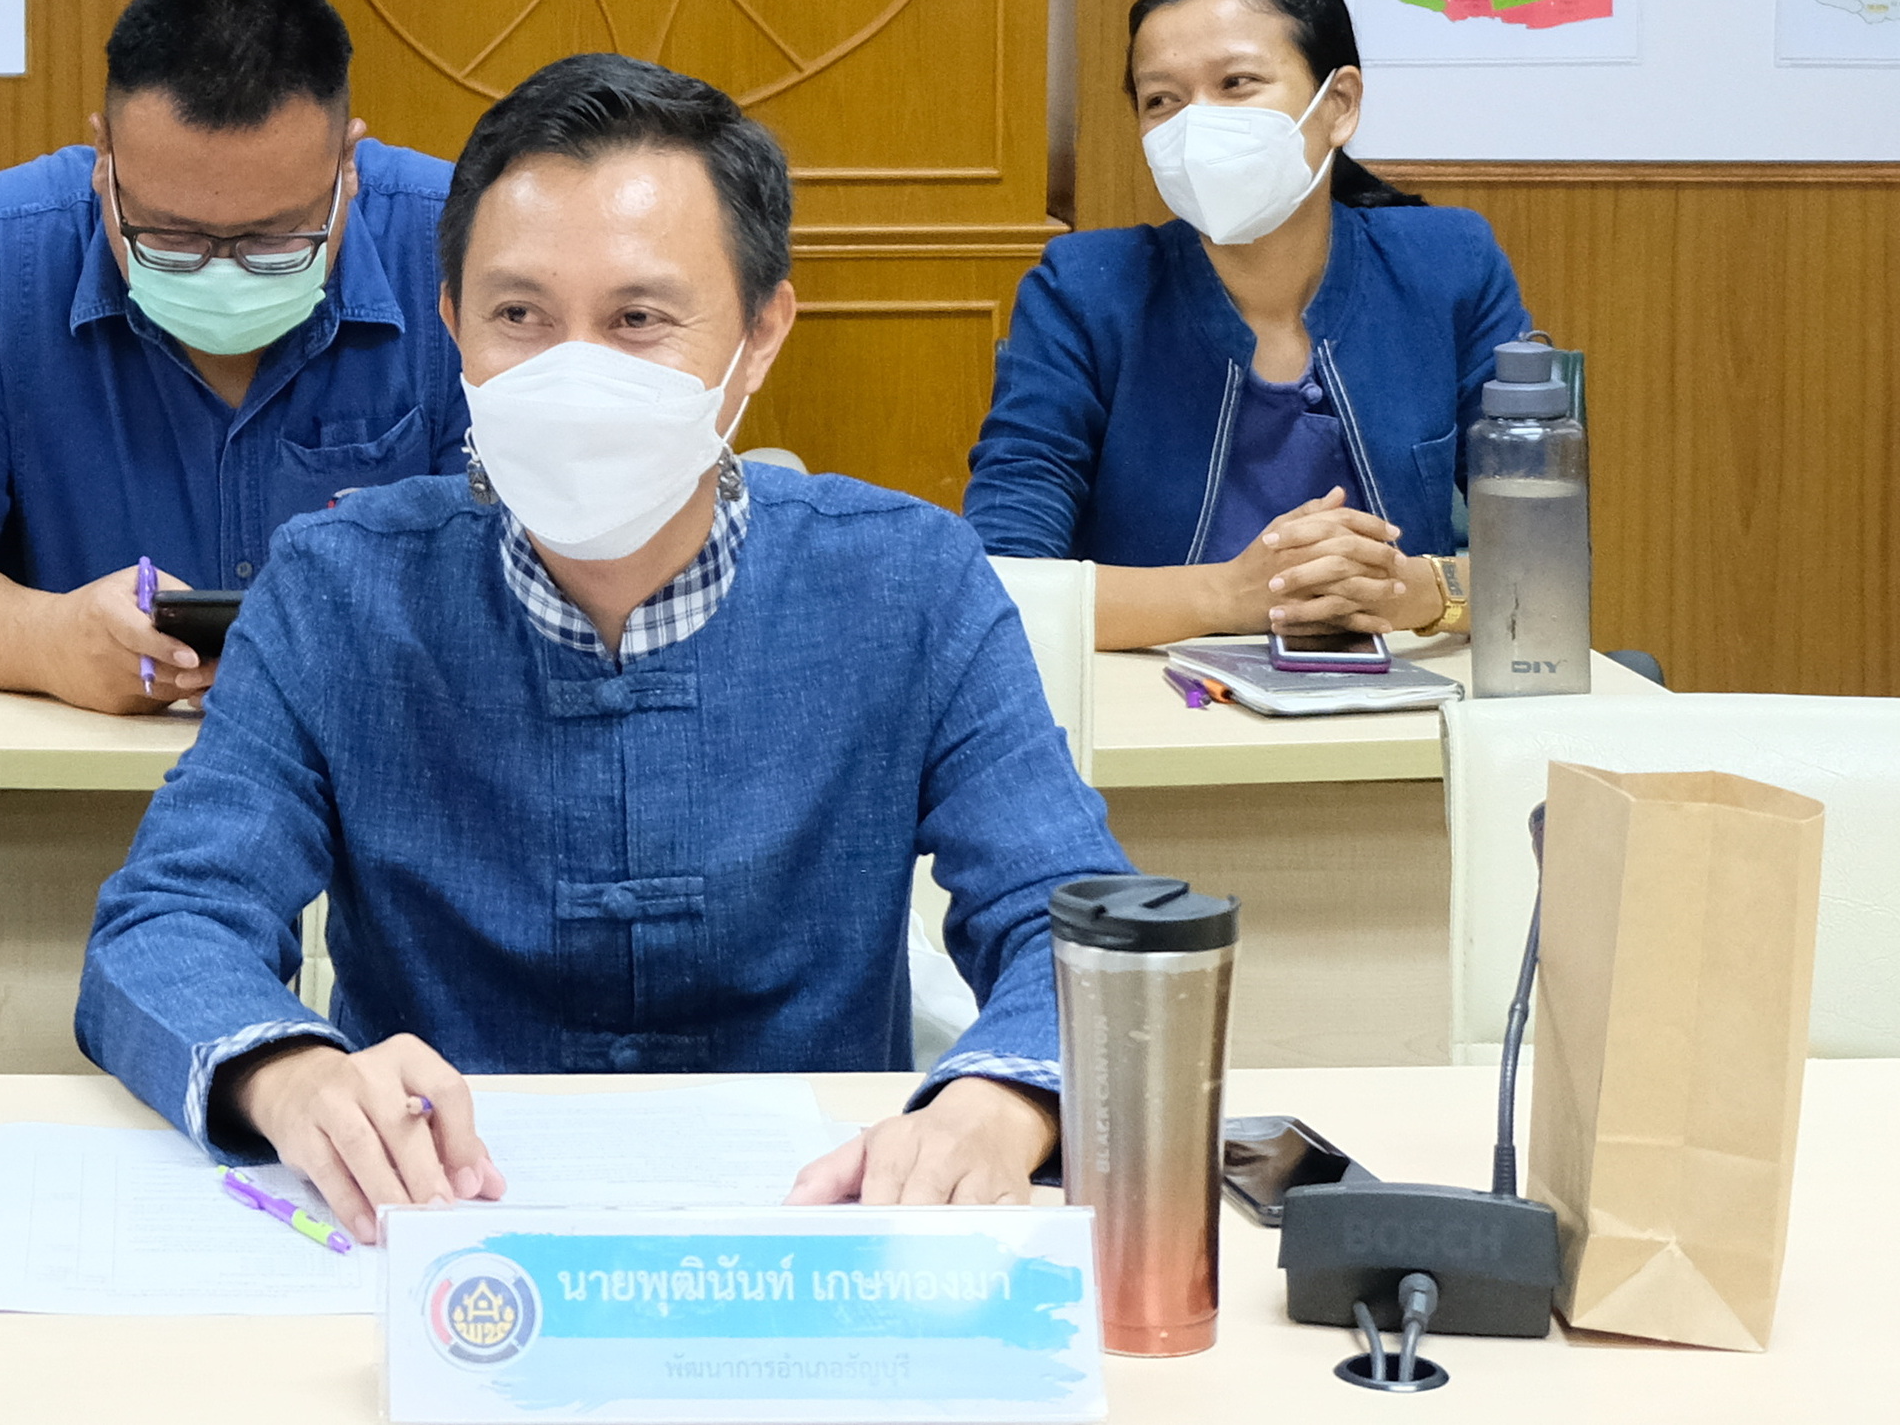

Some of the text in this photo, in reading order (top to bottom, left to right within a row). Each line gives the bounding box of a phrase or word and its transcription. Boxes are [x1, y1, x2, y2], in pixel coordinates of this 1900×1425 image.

[1511, 660, 1560, 674] DIY
[557, 1253, 1011, 1317] นายพุฒินันท์ เกษทองมา
[665, 1352, 911, 1387] พัฒนาการอำเภอธัญบุรี
